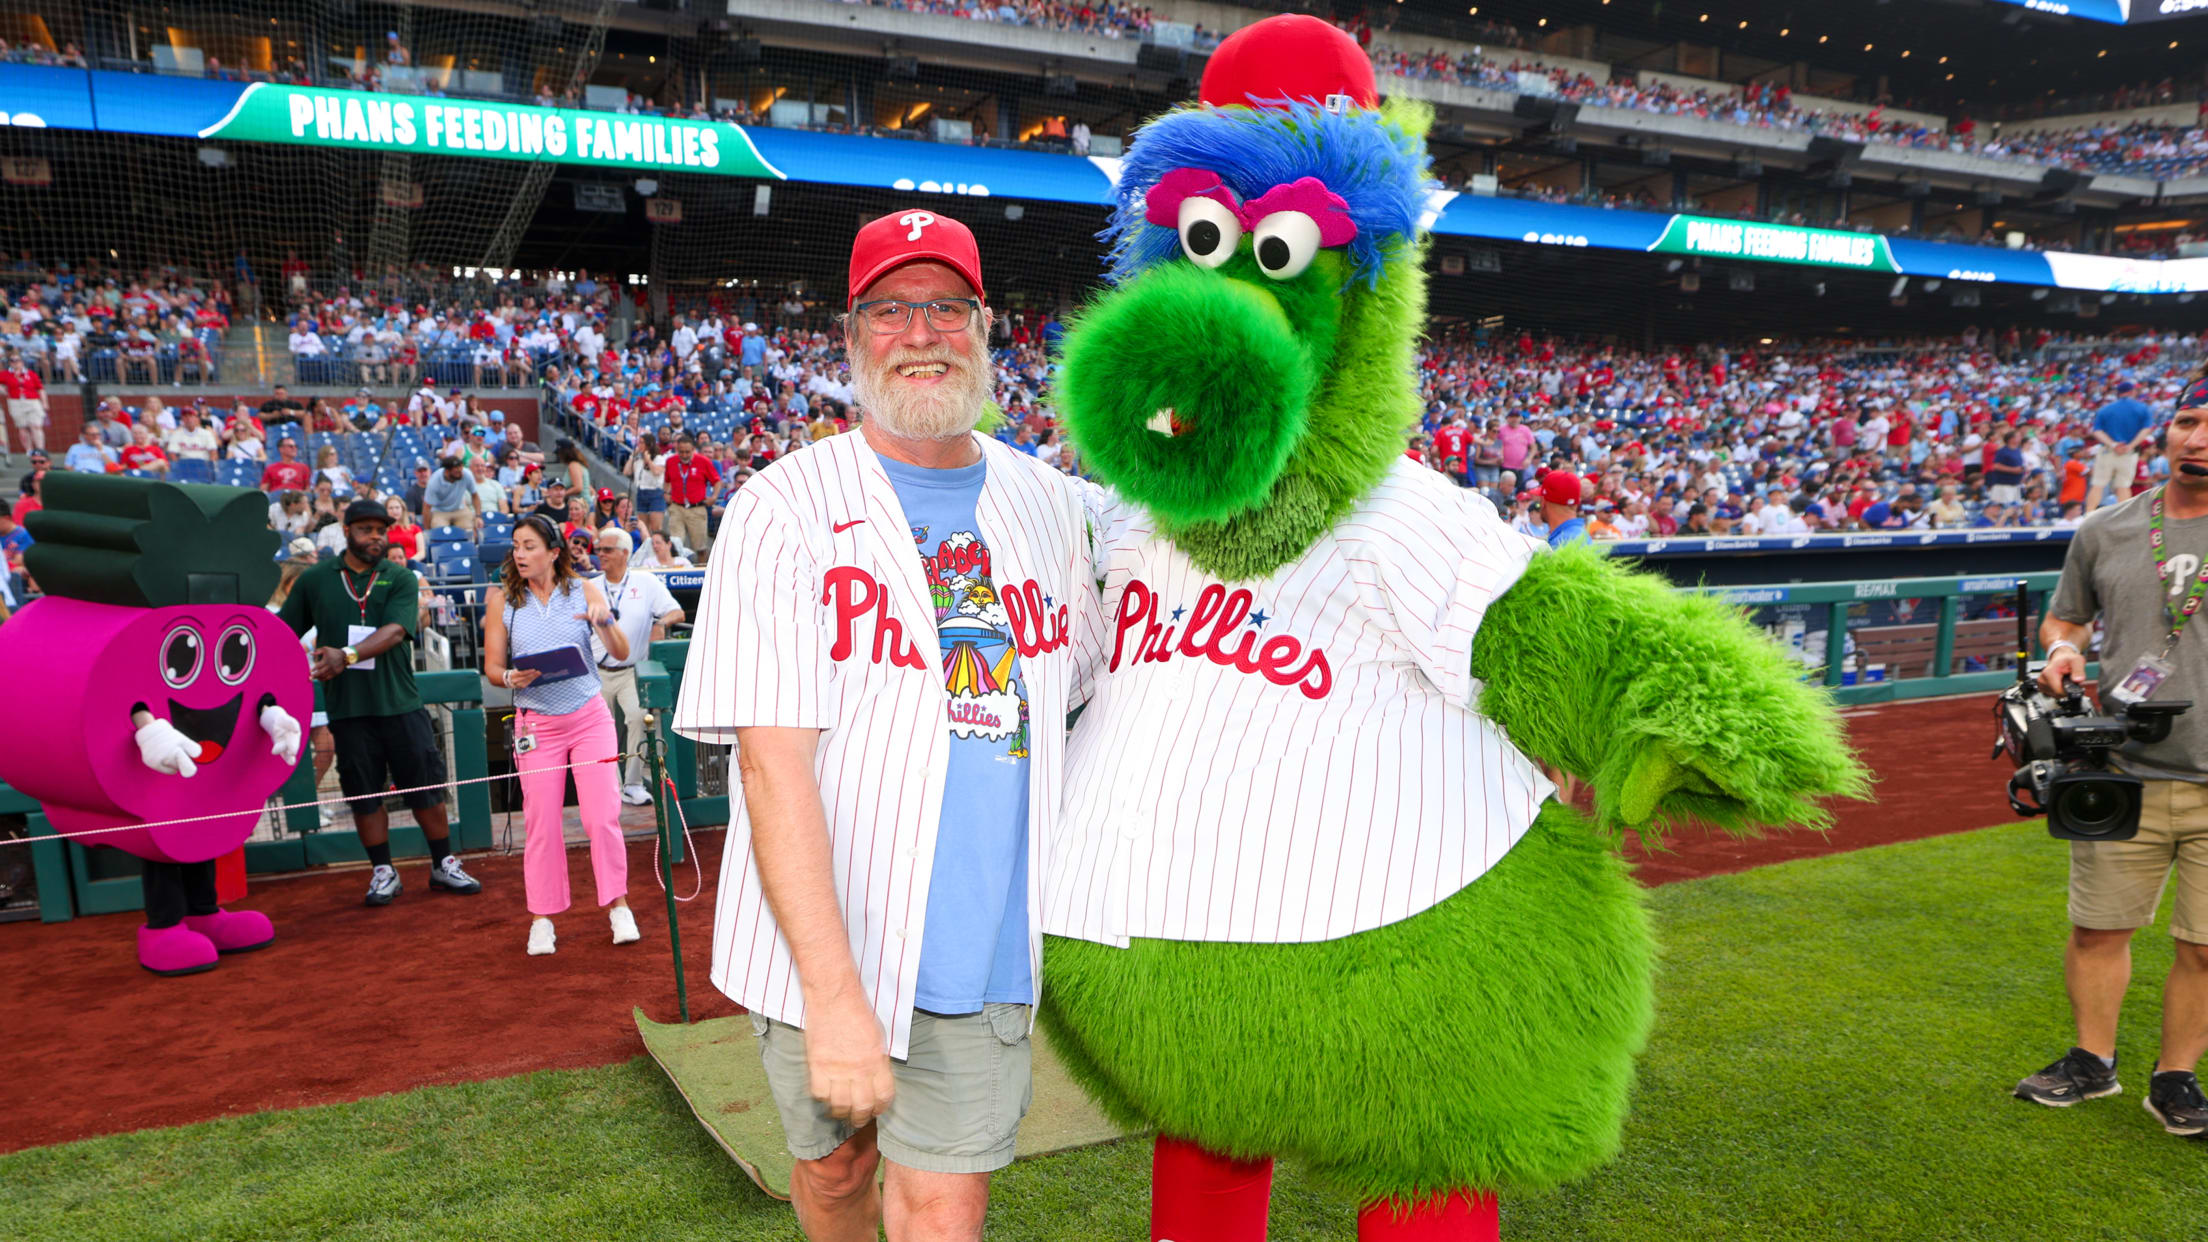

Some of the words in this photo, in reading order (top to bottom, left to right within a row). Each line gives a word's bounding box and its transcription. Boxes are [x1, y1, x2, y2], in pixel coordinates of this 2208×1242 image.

[289, 93, 417, 145] PHANS
[425, 105, 567, 156] FEEDING
[575, 117, 720, 168] FAMILIES
[899, 211, 935, 242] P
[1686, 221, 1742, 254] PHANS
[1743, 226, 1807, 260] FEEDING
[1808, 233, 1875, 267] FAMILIES
[1854, 583, 1898, 598] RE/MAX
[2165, 553, 2199, 596] P
[1109, 579, 1332, 700] Phillies
